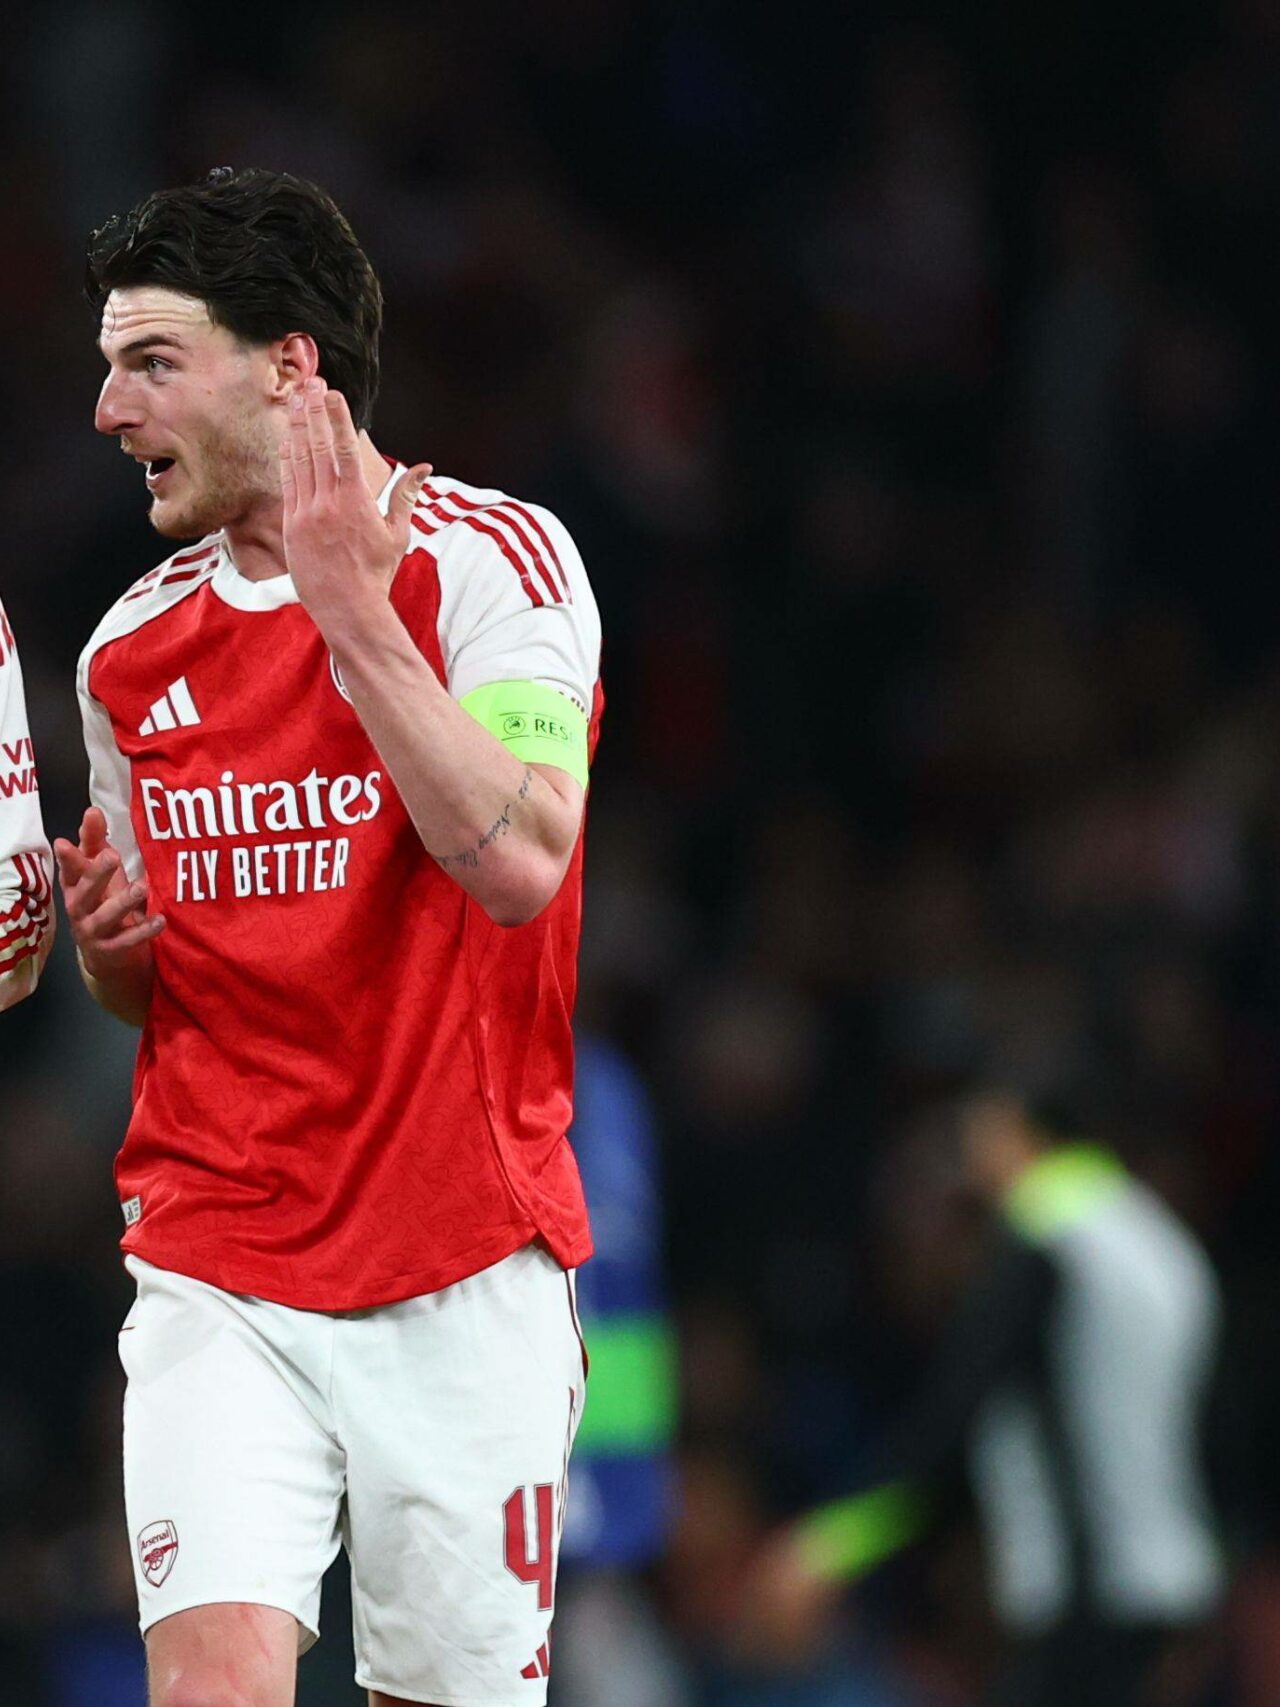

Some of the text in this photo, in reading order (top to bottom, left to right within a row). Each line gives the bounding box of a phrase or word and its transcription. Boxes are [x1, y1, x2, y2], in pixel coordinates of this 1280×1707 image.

[534, 718, 570, 741] RES
[139, 767, 382, 840] Emirates
[176, 837, 350, 902] FLY BETTER
[141, 1530, 170, 1549] Arsenal
